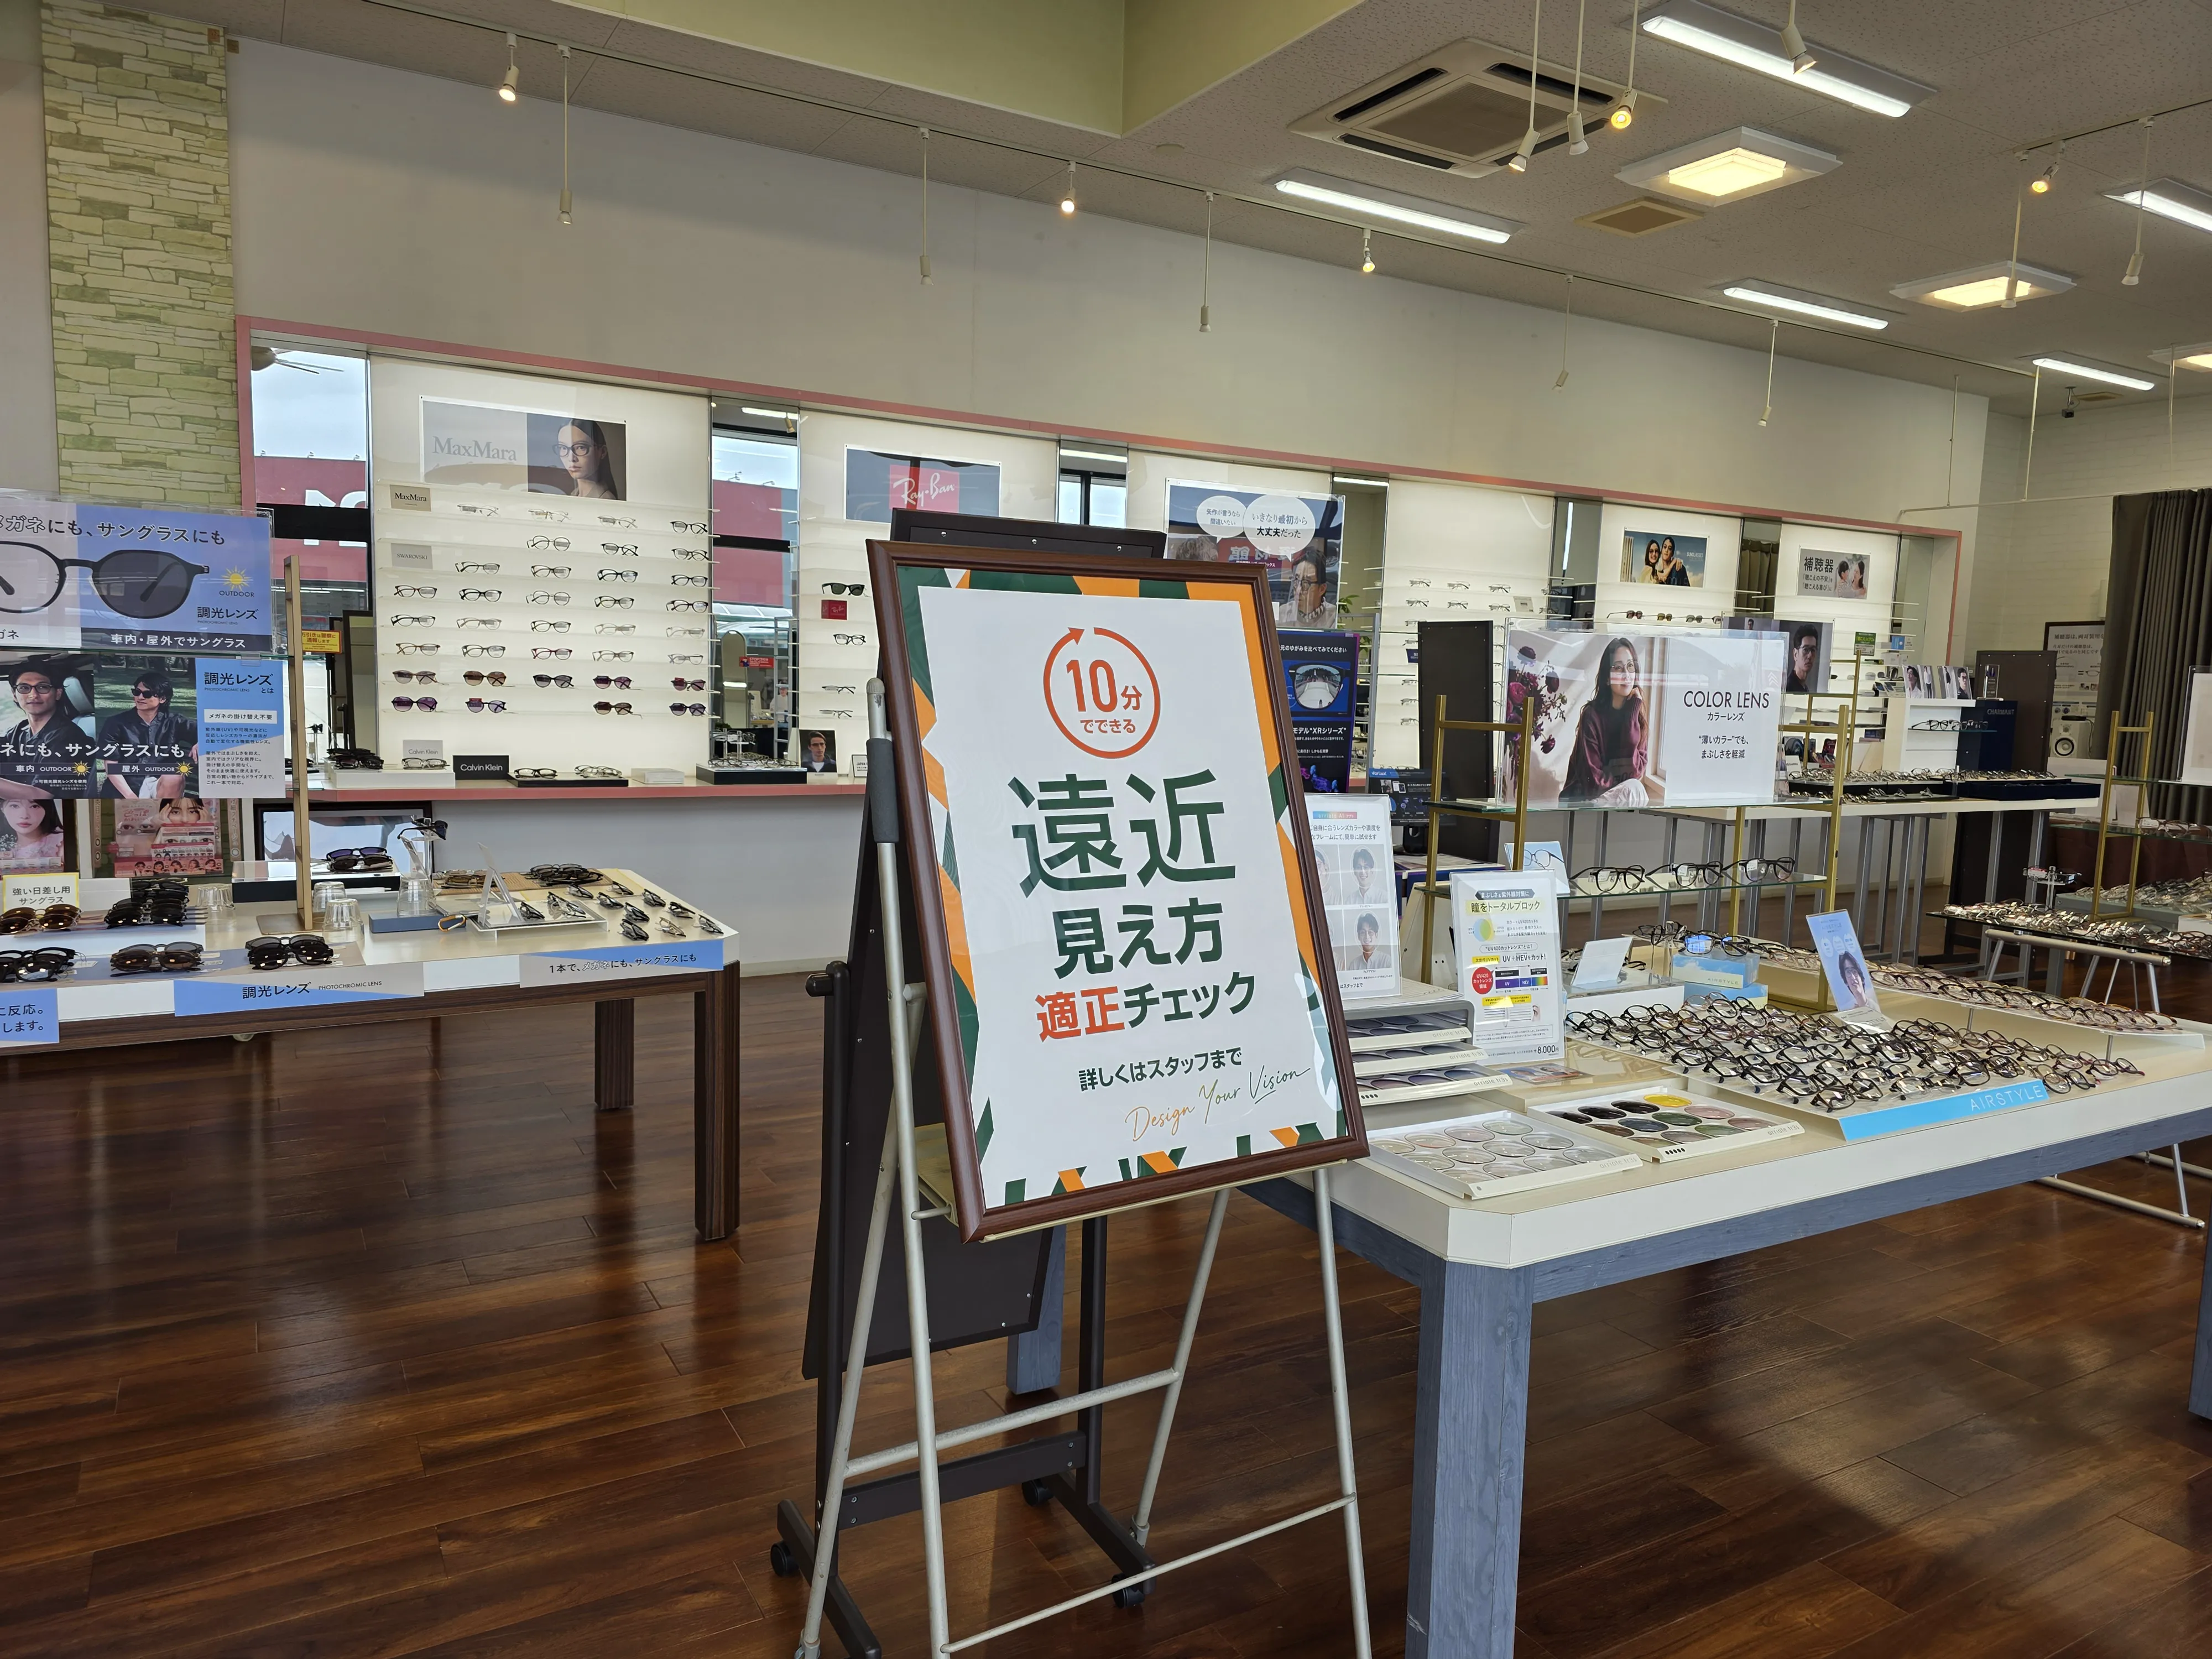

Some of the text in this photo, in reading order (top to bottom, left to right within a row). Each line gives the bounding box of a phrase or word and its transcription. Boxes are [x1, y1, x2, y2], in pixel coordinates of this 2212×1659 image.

[432, 436, 517, 461] MaxMara
[394, 492, 427, 502] MaxMara
[1206, 508, 1240, 517] 矢作が言うなら
[1252, 513, 1308, 525] いきなり最初から
[0, 515, 225, 545] ガネにも、サングラスにも
[1256, 527, 1301, 539] 大丈夫だった
[1804, 556, 1834, 573] 補聴器
[197, 606, 259, 620] 調光レンズ
[111, 633, 246, 648] 車内・屋外でサングラス
[204, 672, 274, 686] 調光レンズ
[1066, 659, 1142, 712] 10分
[1684, 691, 1770, 708] COLOR LENS
[1707, 712, 1745, 721] カラーレンズ
[1080, 719, 1136, 734] でできる
[0, 743, 184, 758] ネにも、サングラスにも
[1701, 749, 1745, 759] まぶしさを軽減
[1008, 769, 1236, 897] 遠近
[12, 886, 71, 896] 強い日差し用
[18, 896, 64, 905] サングラス
[1471, 900, 1540, 913] 瞳をトータルブロック
[1053, 897, 1224, 979] 見え方
[242, 981, 312, 999] 調光レンズ
[318, 982, 367, 990] PHOTOCHROMIC
[1034, 972, 1256, 1042] 適正チェック
[1078, 1046, 1243, 1092] 詳しくはスタッフまで
[1124, 1065, 1311, 1142] Design Your Vision
[1971, 1085, 2044, 1112] AIRSTYLE
[1767, 1126, 1788, 1136] arriate
[1599, 1159, 1623, 1169] arriate
